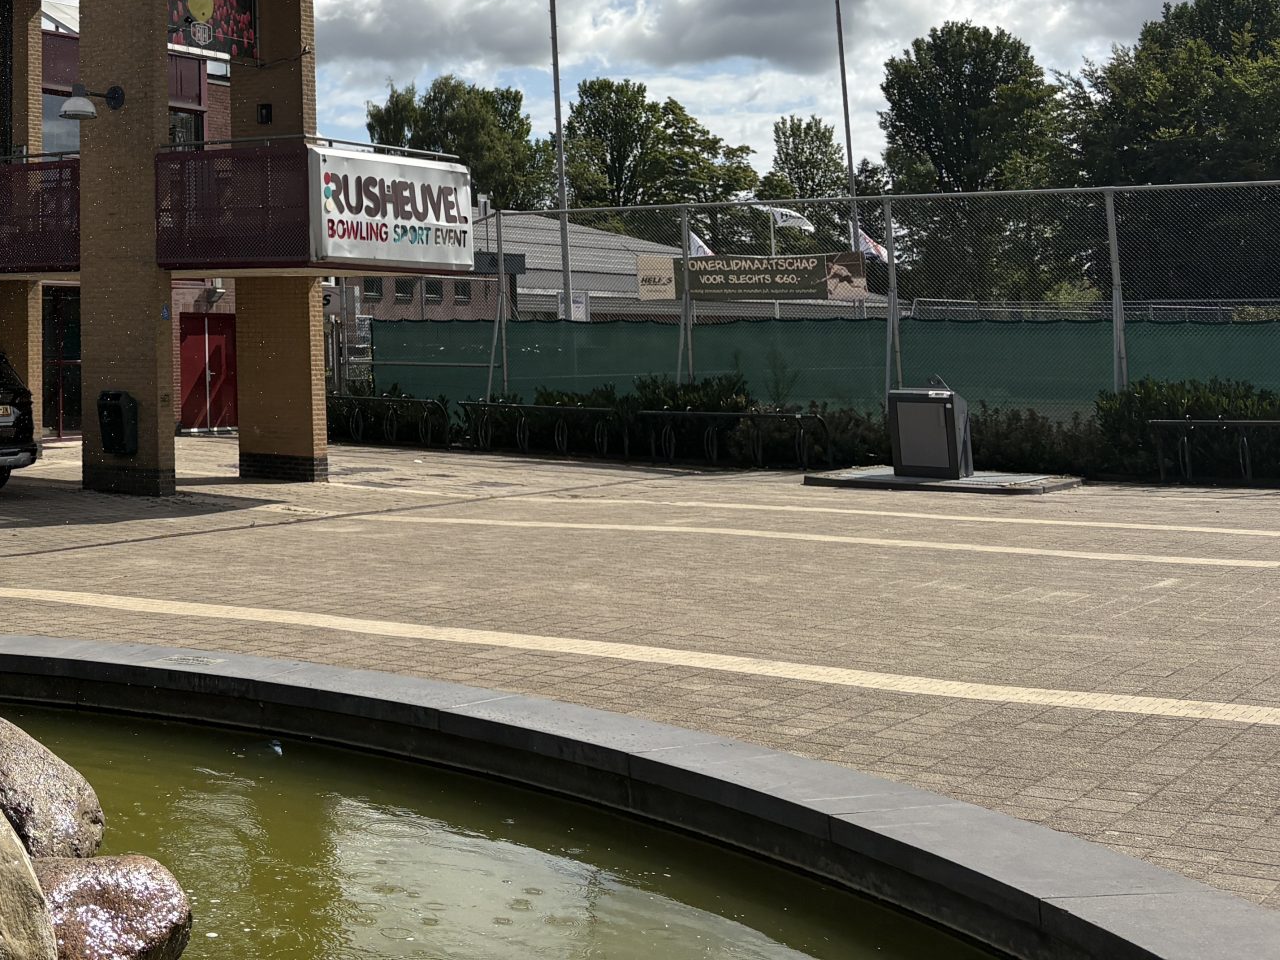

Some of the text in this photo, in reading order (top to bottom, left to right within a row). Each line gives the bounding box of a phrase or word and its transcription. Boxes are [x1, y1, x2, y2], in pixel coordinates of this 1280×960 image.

[324, 172, 468, 224] RUSHEUVEL
[327, 219, 468, 248] BOWLING SPORT EVENT
[681, 258, 818, 271] OMERLIDMAATSCHAP
[700, 274, 725, 284] VOOR
[728, 274, 772, 284] SLECHTS
